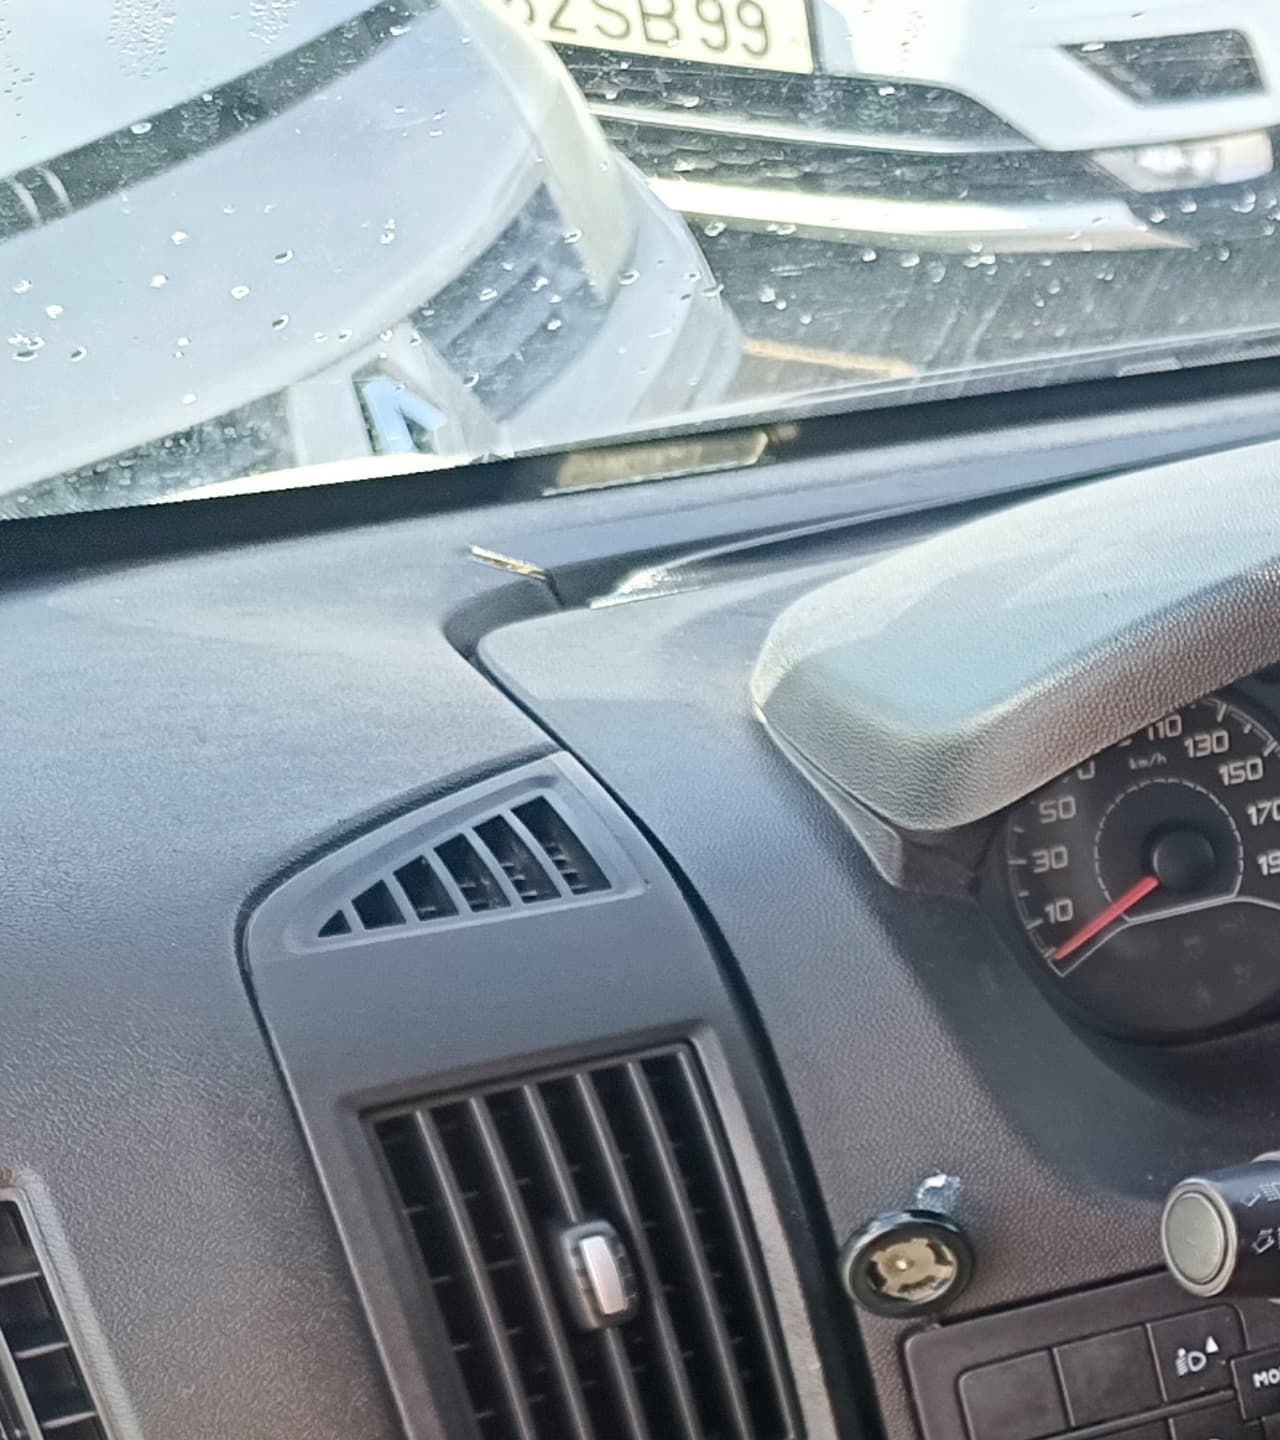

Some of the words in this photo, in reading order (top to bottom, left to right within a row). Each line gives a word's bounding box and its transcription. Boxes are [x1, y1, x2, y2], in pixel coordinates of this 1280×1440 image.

[1184, 730, 1229, 758] 130
[1219, 757, 1263, 786] 150
[1038, 795, 1077, 823] 50
[1032, 846, 1068, 873] 30
[1044, 899, 1073, 923] 10
